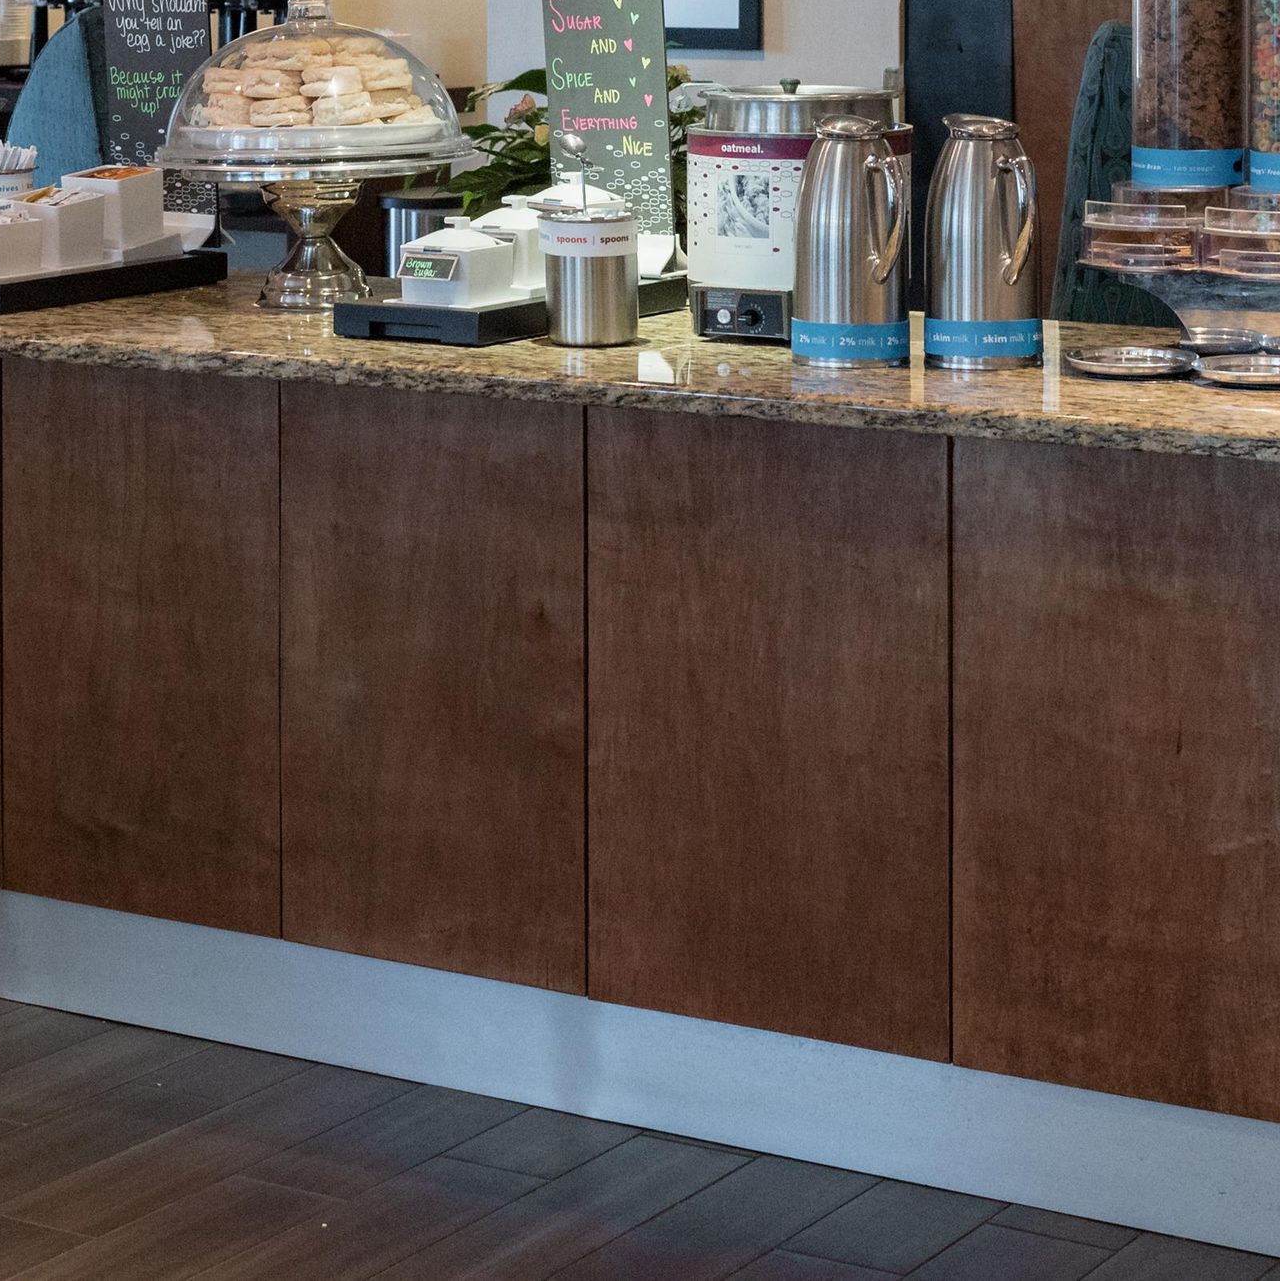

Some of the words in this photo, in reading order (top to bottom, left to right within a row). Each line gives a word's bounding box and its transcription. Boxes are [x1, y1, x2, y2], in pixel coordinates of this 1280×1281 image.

[116, 16, 139, 37] you
[144, 17, 163, 31] tell
[167, 17, 183, 31] an
[126, 32, 151, 53] egg
[155, 34, 166, 47] a
[169, 29, 206, 54] joke??
[590, 38, 617, 54] AND
[110, 66, 165, 85] Because
[171, 71, 183, 84] it
[116, 85, 151, 108] might
[156, 86, 183, 102] crac
[593, 88, 620, 104] AND
[140, 97, 160, 118] up!
[623, 135, 653, 157] NICE
[721, 144, 764, 154] oatmeal.
[556, 235, 588, 244] spoons
[600, 235, 629, 245] spoons
[405, 258, 433, 269] Brown
[799, 334, 810, 344] 2%
[840, 337, 856, 346] 2%
[887, 336, 899, 346] 2%
[932, 333, 951, 343] skim
[982, 334, 1007, 343] skim
